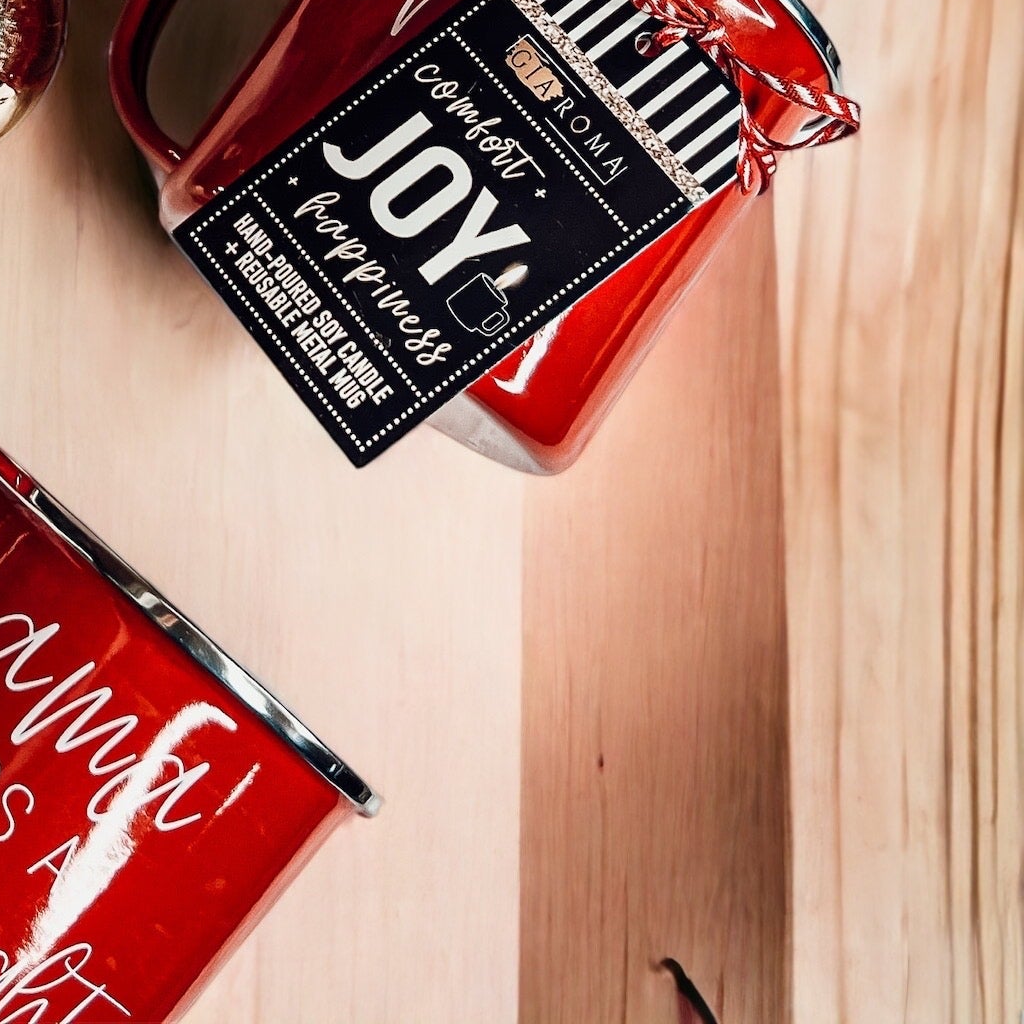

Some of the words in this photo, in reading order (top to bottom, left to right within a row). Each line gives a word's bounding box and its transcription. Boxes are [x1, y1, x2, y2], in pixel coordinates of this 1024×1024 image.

[322, 111, 532, 285] JOY
[414, 64, 545, 179] comfort
[233, 212, 322, 316] HAND-POURED
[312, 309, 348, 346] SOY
[337, 341, 395, 406] CANDLE
[234, 251, 303, 328] REUSABLE
[291, 319, 339, 376] METAL
[328, 368, 367, 409] MUG
[293, 191, 453, 366] happiness
[27, 835, 80, 898] A
